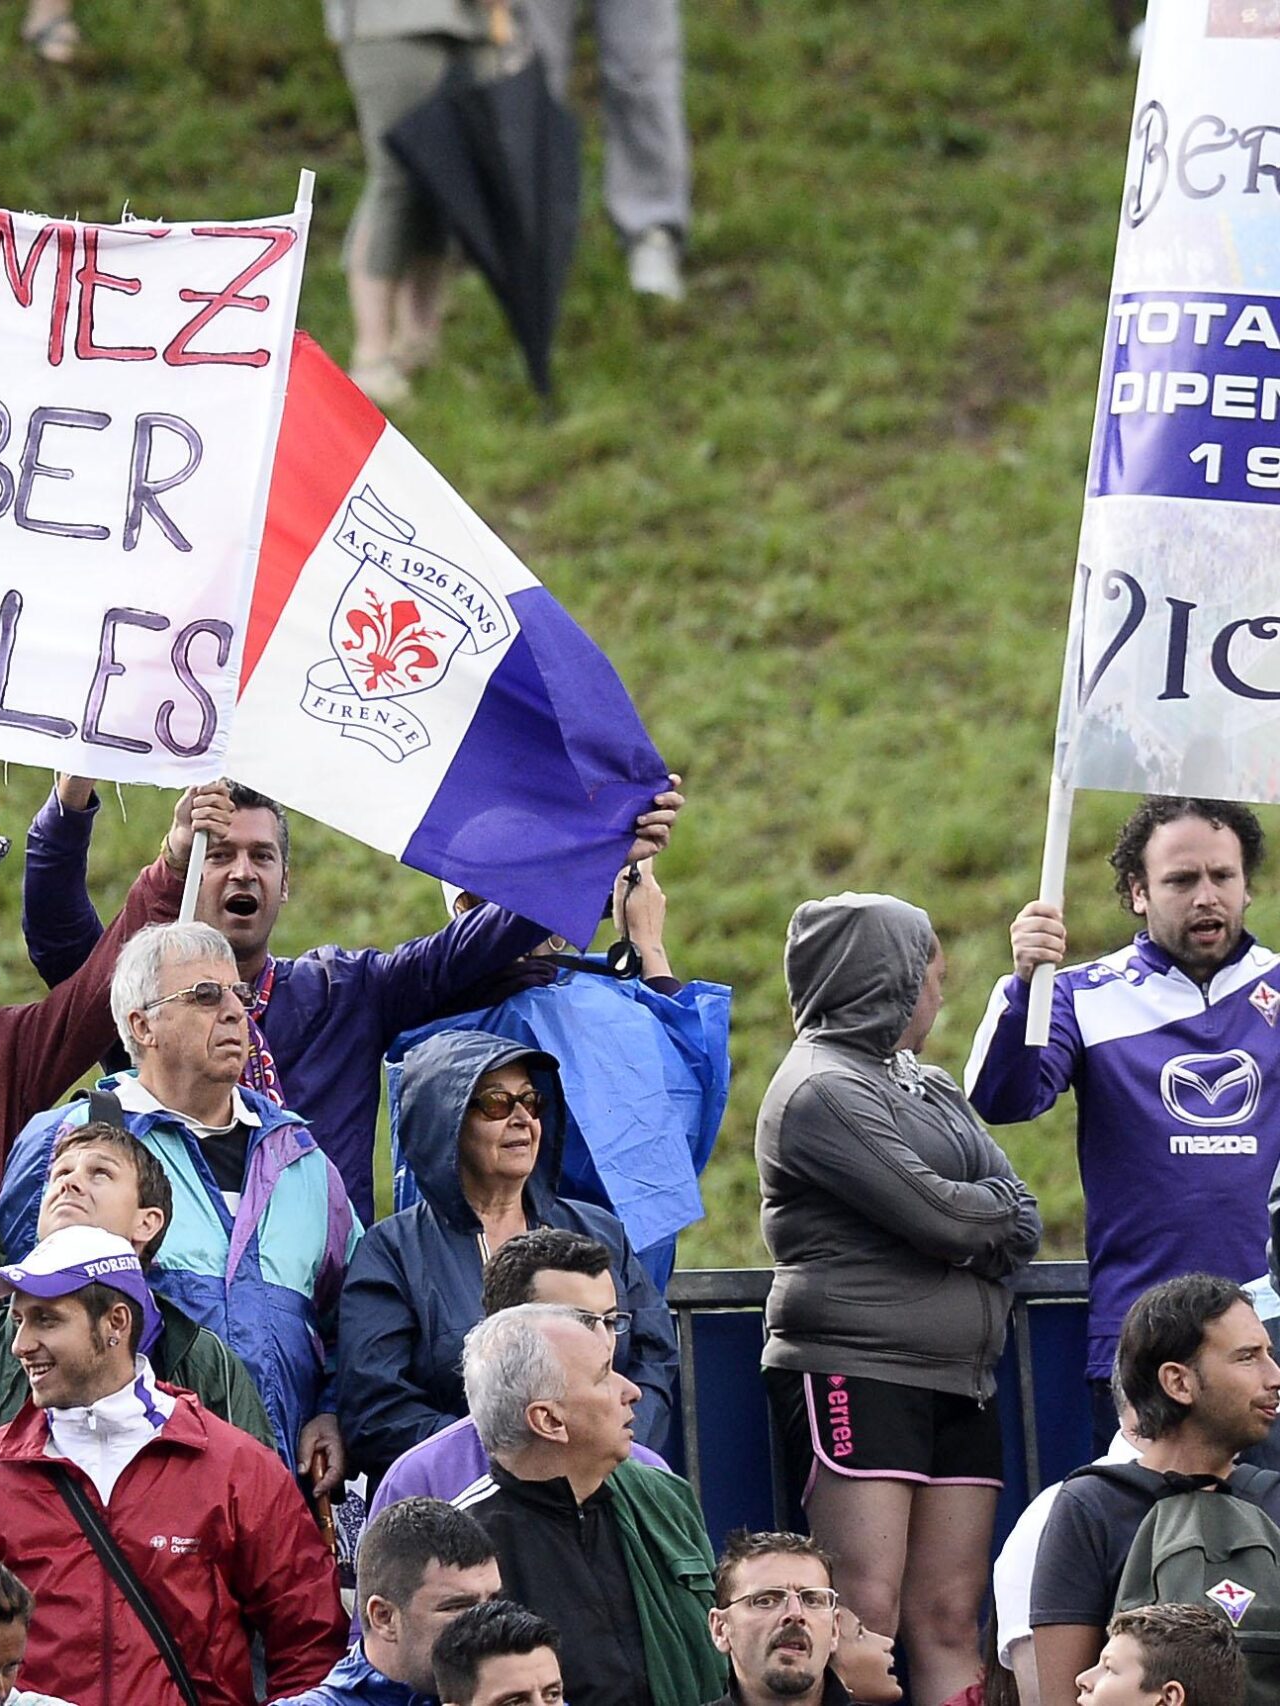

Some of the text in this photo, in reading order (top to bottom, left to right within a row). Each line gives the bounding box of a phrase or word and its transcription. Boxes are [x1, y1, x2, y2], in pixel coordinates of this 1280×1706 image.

[1113, 302, 1280, 349] TOTA
[343, 530, 497, 634] A.C.F. 1926 FANS
[312, 696, 419, 744] FIRENZE
[1169, 1135, 1258, 1154] mazda
